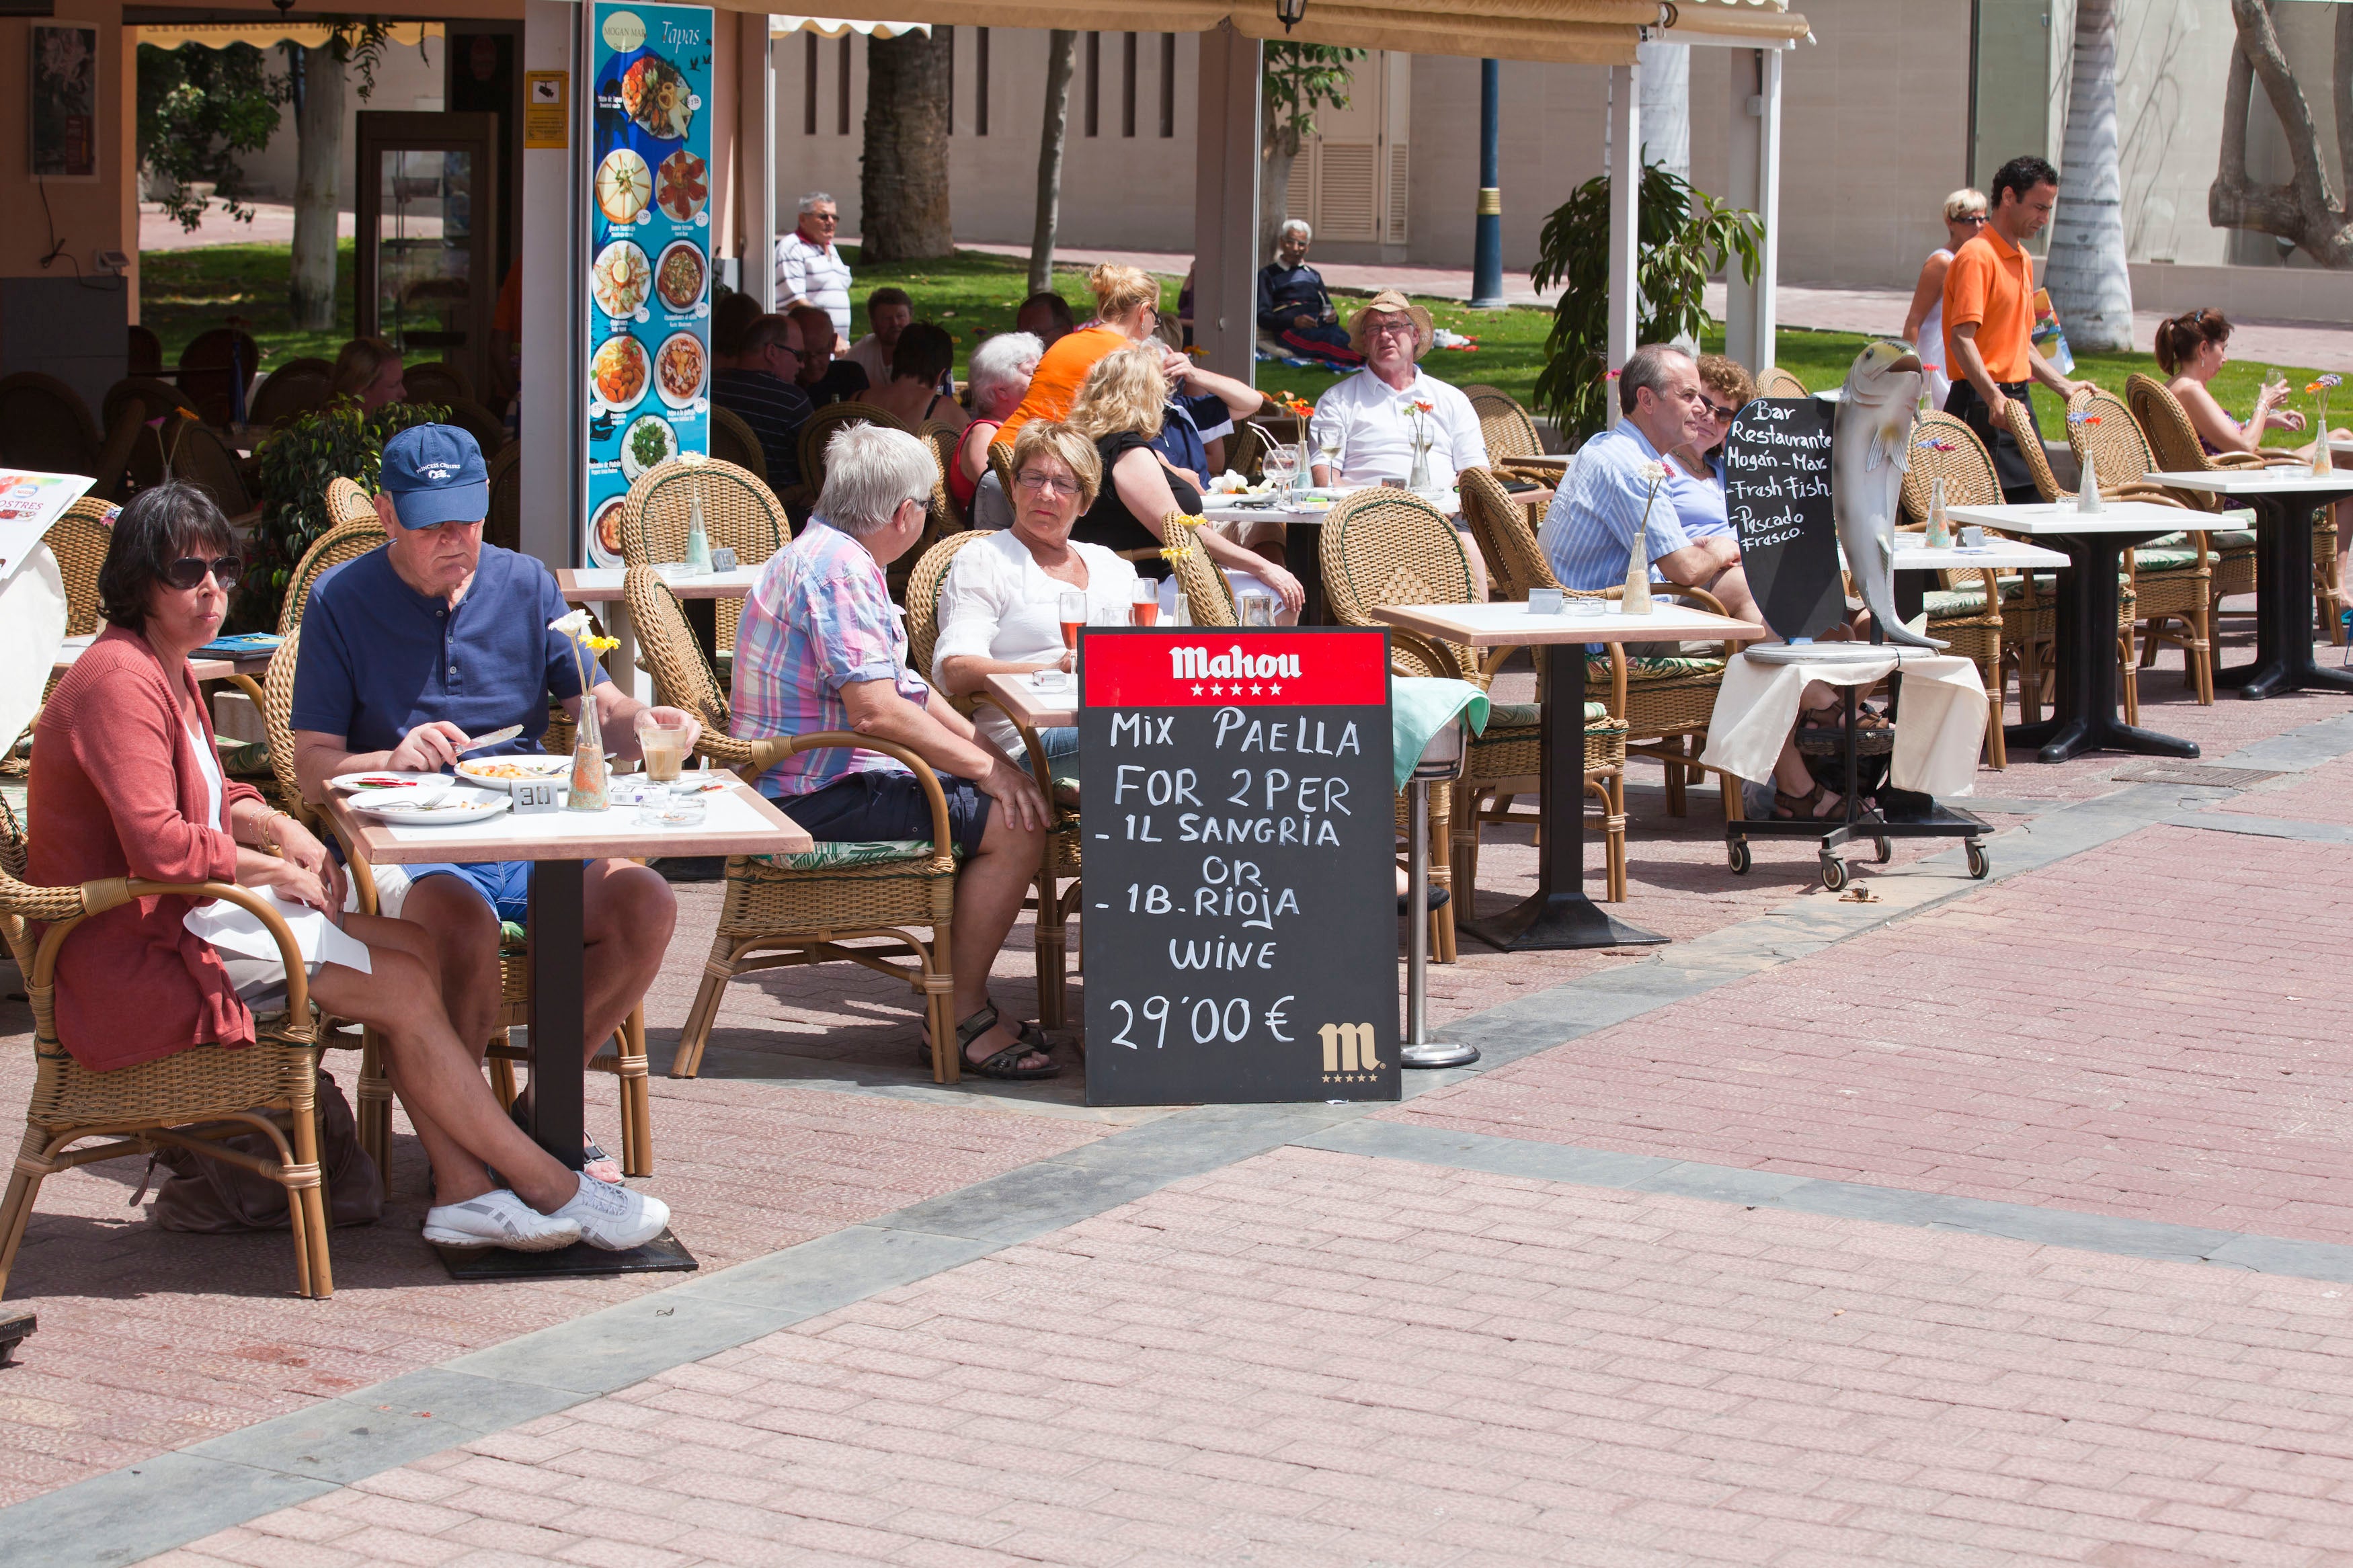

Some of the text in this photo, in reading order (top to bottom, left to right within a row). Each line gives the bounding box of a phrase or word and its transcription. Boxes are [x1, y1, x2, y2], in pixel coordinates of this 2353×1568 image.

[604, 27, 630, 36] MOGAN
[662, 21, 700, 54] Tapas
[1749, 400, 1796, 421] Bar
[1730, 421, 1832, 450] Restaurante
[1727, 446, 1778, 471] Mogán
[1213, 706, 1360, 757] PAELLA
[1115, 765, 1203, 807] FOR
[1201, 856, 1262, 887] OR
